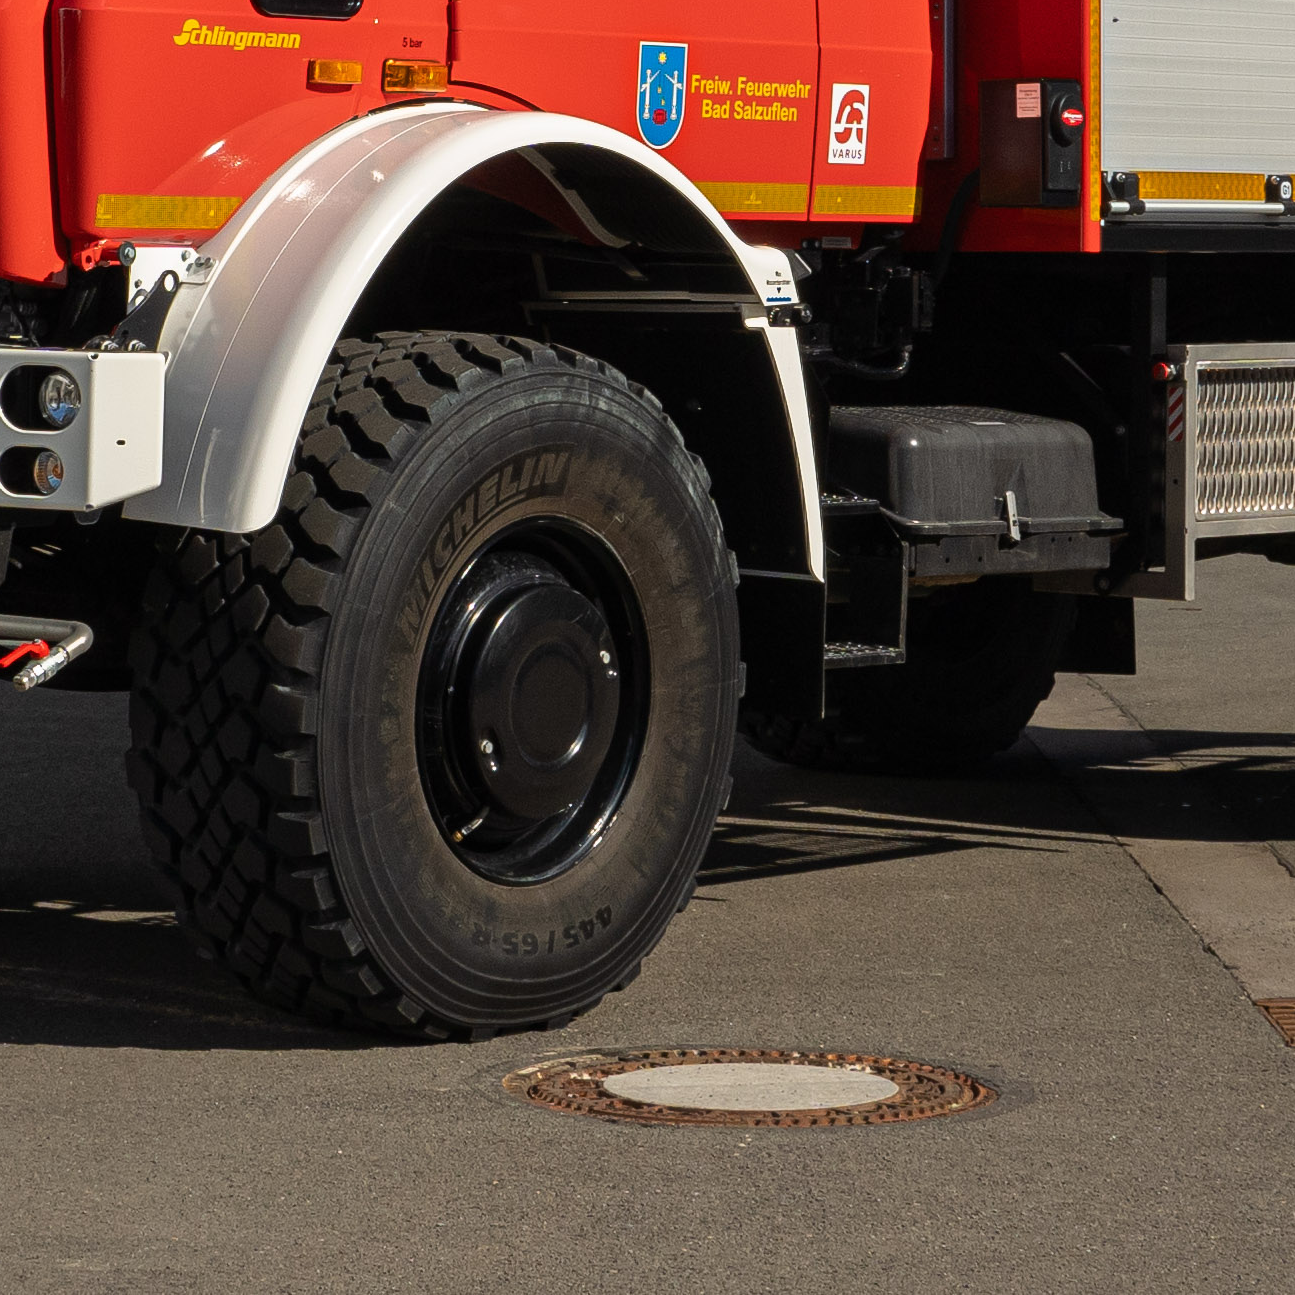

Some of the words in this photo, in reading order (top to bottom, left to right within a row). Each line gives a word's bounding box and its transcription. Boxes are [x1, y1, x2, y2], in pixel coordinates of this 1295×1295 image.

[173, 18, 301, 51] Schlingmann
[402, 37, 408, 48] 5
[410, 37, 423, 48] bar
[691, 74, 733, 95] Freiw.
[737, 76, 811, 99] Feuerwehr
[701, 99, 730, 119] Bad
[733, 101, 798, 122] Salzuflen
[832, 148, 862, 160] VARUS
[398, 452, 570, 649] MICHELIN
